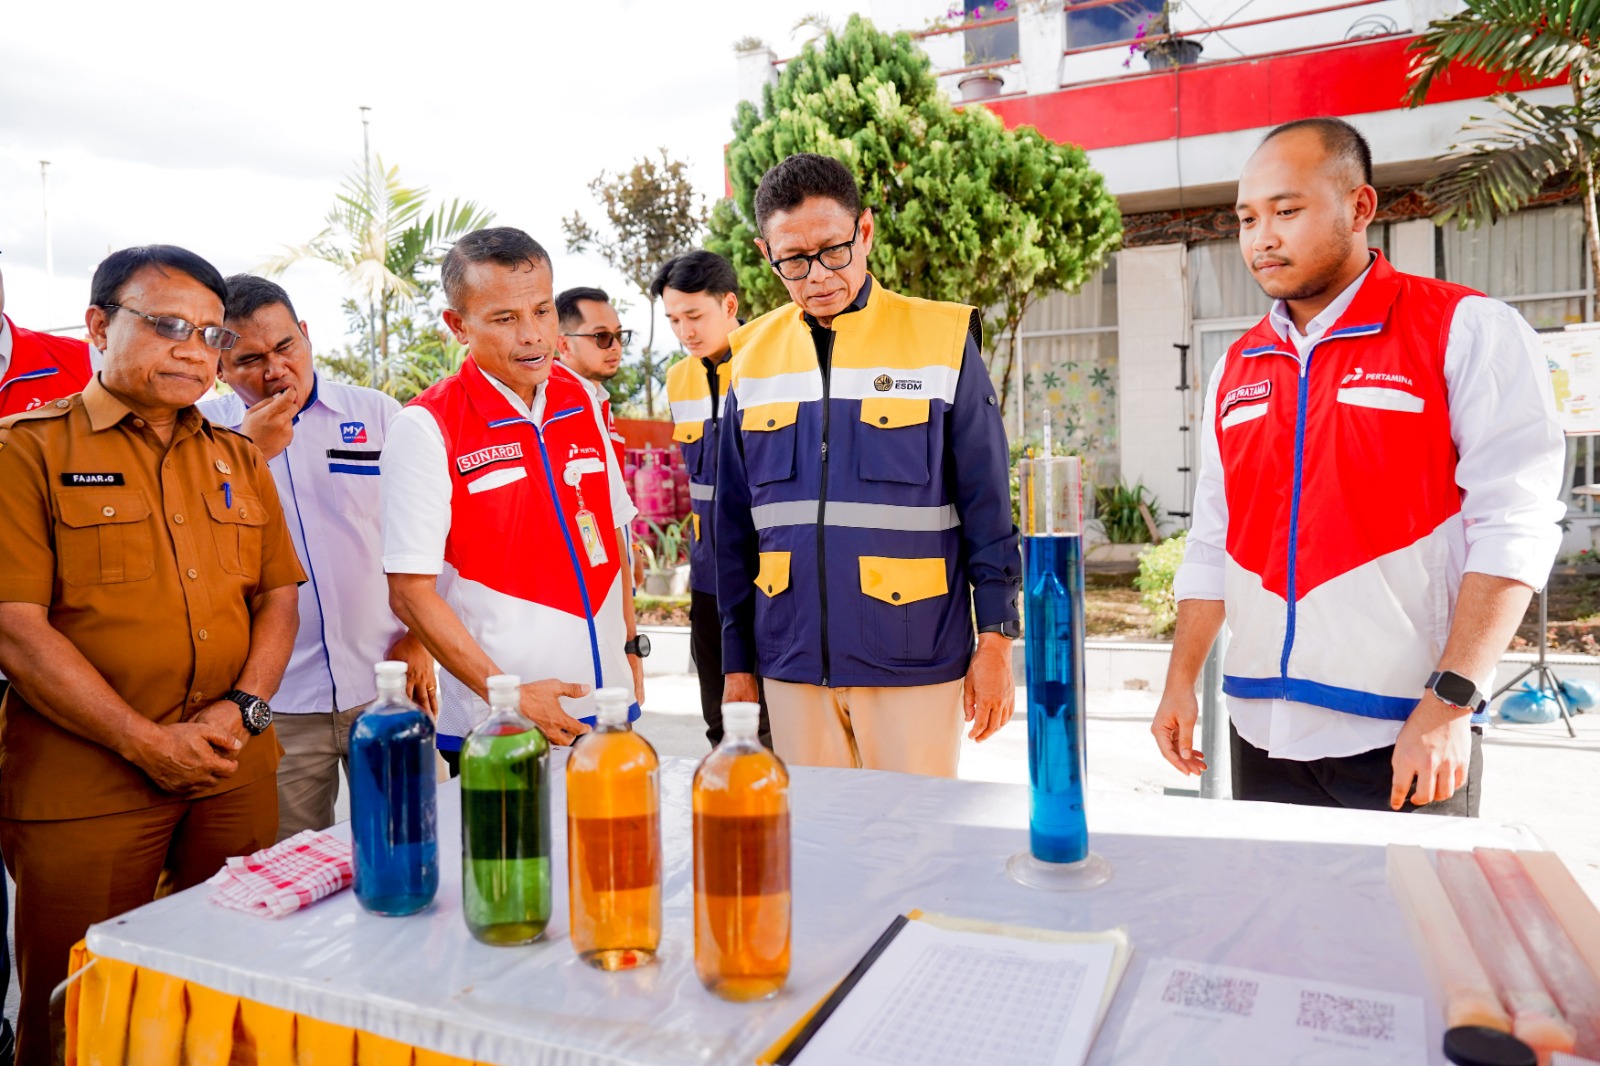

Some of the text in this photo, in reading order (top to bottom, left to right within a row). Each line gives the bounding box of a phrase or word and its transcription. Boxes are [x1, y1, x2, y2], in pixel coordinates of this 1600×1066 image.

[1365, 373, 1413, 386] PERTAMINA
[895, 383, 922, 391] ESDM
[1237, 384, 1266, 398] PRATAMA
[461, 445, 519, 468] SUNARDI
[73, 474, 114, 483] FAJAR.G
